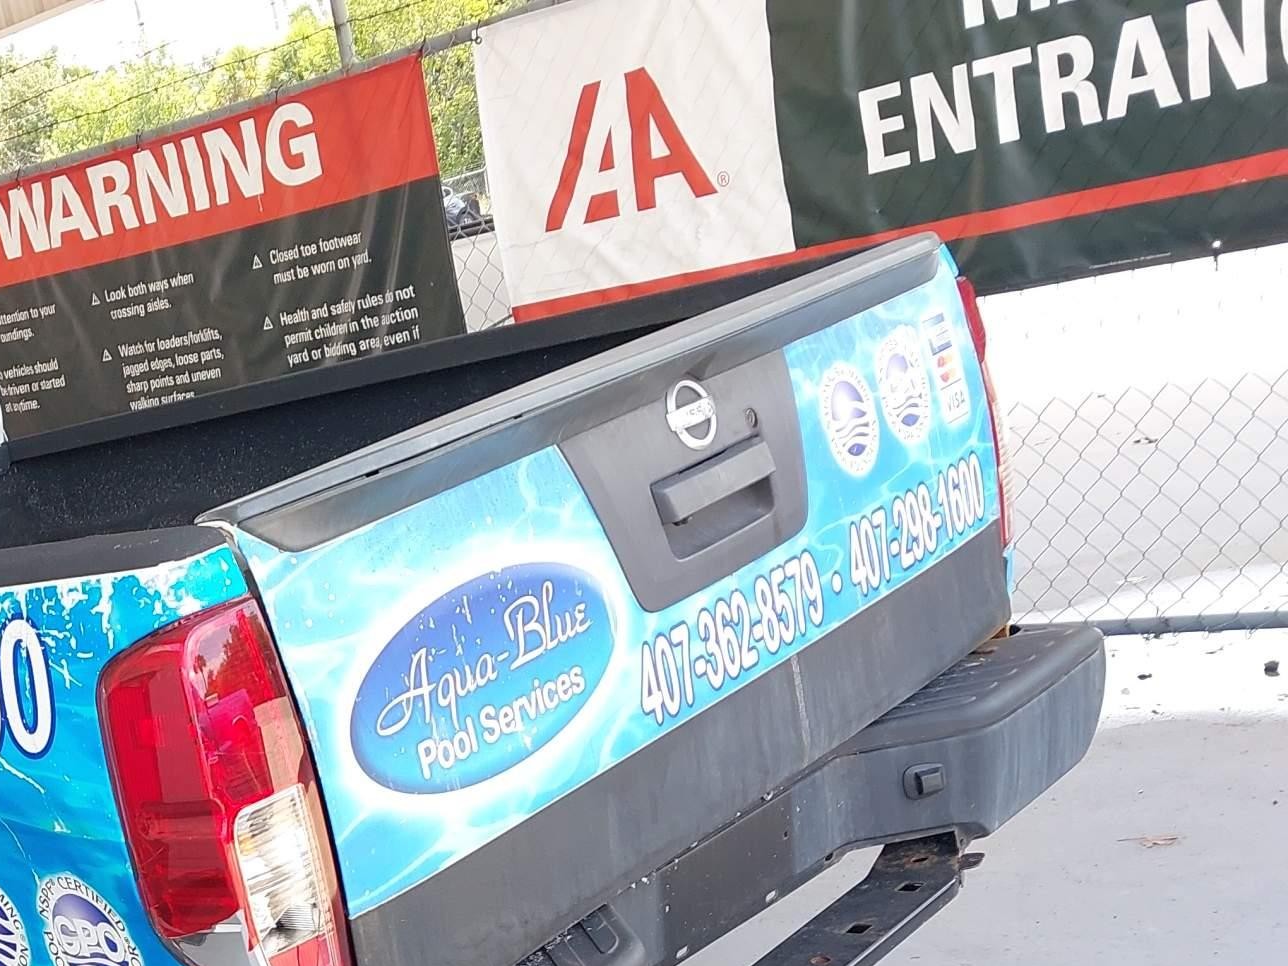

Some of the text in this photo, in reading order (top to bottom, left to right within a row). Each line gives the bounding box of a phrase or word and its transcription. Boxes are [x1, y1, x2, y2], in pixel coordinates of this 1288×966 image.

[857, 0, 1288, 175] ENTRAN
[269, 232, 362, 265] Closed toe footwear
[273, 248, 372, 285] must be worn on yard.
[104, 272, 194, 303] Look both ways when
[30, 308, 39, 319] to
[39, 304, 56, 319] your
[110, 297, 171, 320] crossing aisles.
[279, 284, 416, 327] Health and safety rules do not
[118, 327, 223, 358] Watch for loaders/forklifts,
[284, 306, 419, 348] permit children in the auction
[122, 347, 225, 378] jagged edges, loose parts,
[287, 324, 421, 368] yard or bidding area, even if
[3, 364, 35, 379] vehicles
[34, 358, 59, 374] should
[31, 381, 40, 392] or
[40, 374, 66, 390] started
[126, 367, 222, 394] sharp points and uneven
[641, 451, 985, 725] 407-362-8579 407-298-1600
[376, 580, 593, 736] Aqua-Blue
[417, 666, 586, 780] Pool Services
[56, 876, 126, 932] CERTIFIED
